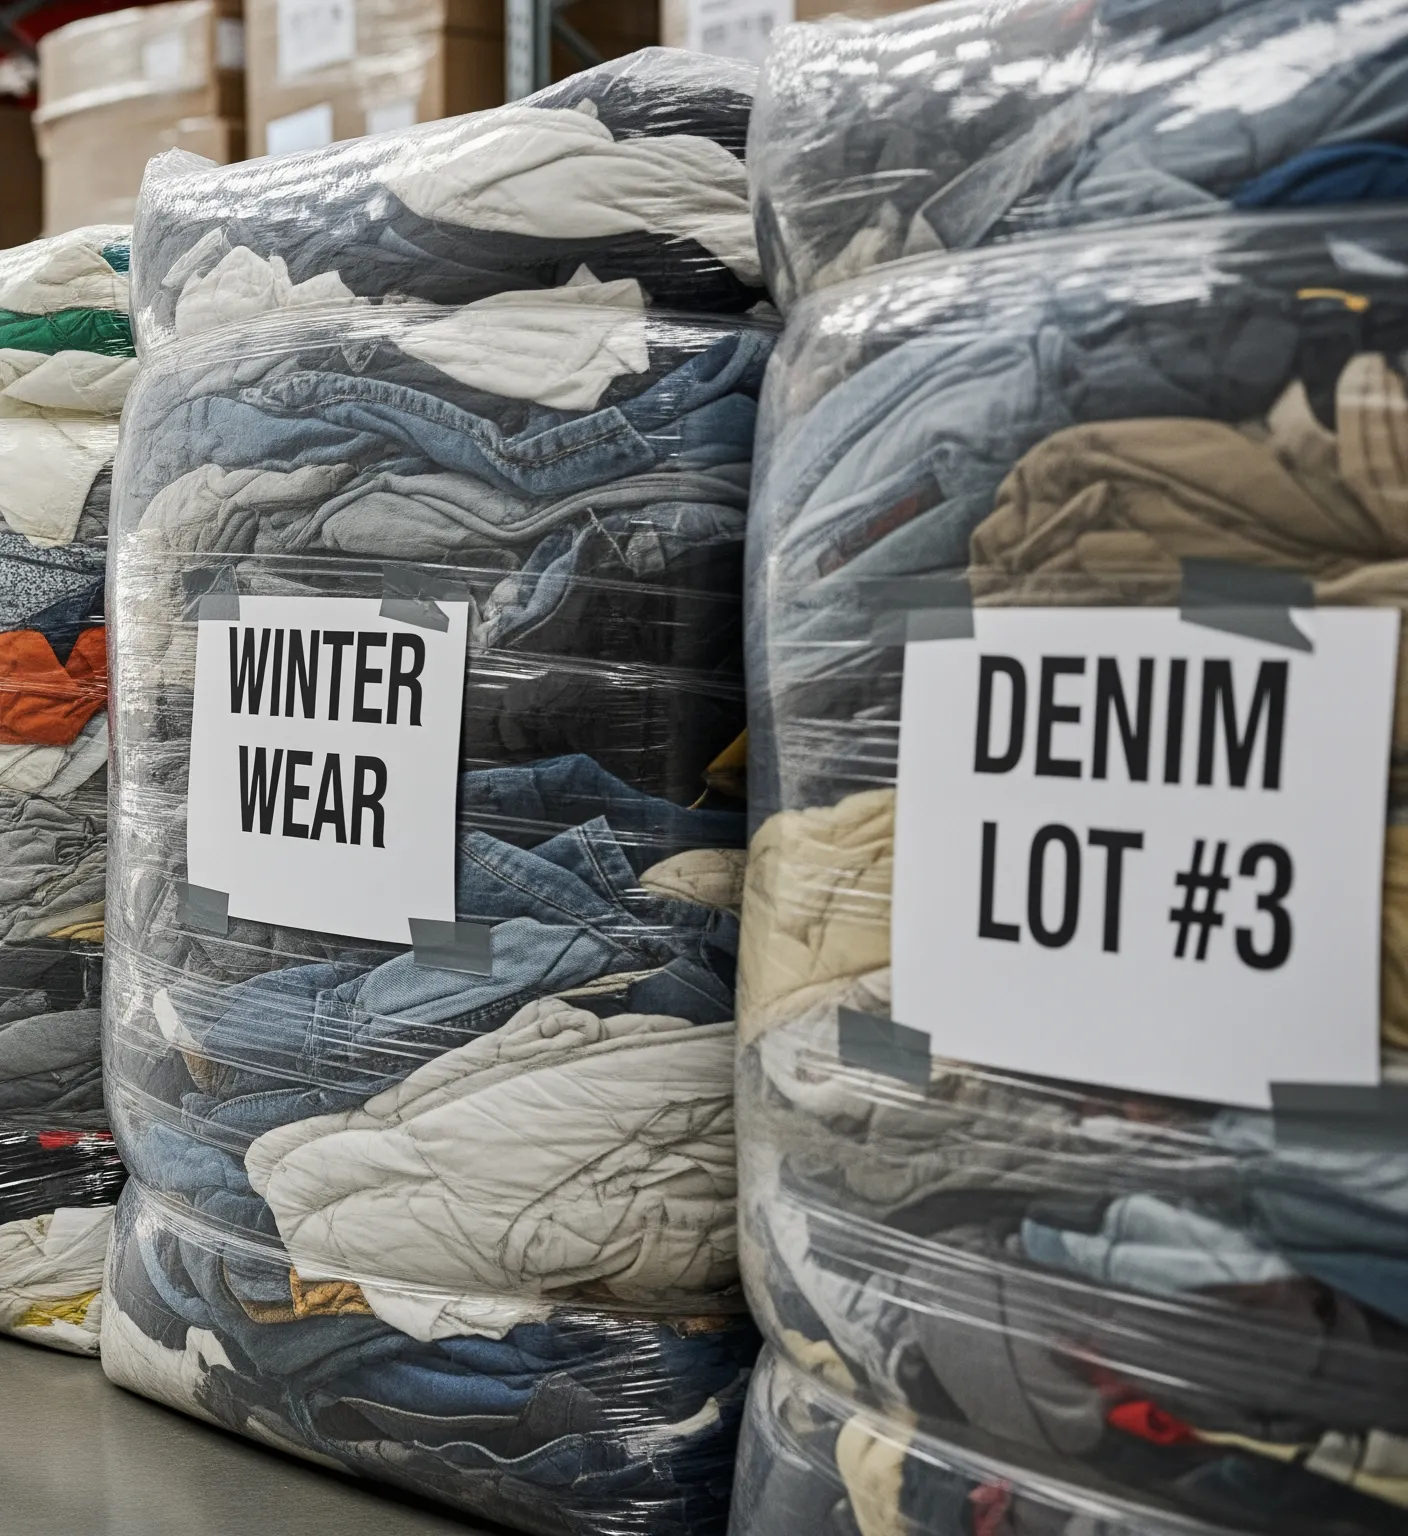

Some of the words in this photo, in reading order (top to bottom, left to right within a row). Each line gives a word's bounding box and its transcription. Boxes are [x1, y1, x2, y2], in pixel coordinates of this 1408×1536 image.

[229, 627, 426, 727] WINTER
[974, 655, 1289, 790] DENIM
[239, 745, 388, 849] WEAR
[979, 822, 1144, 952] LOT
[1170, 840, 1294, 970] #3
